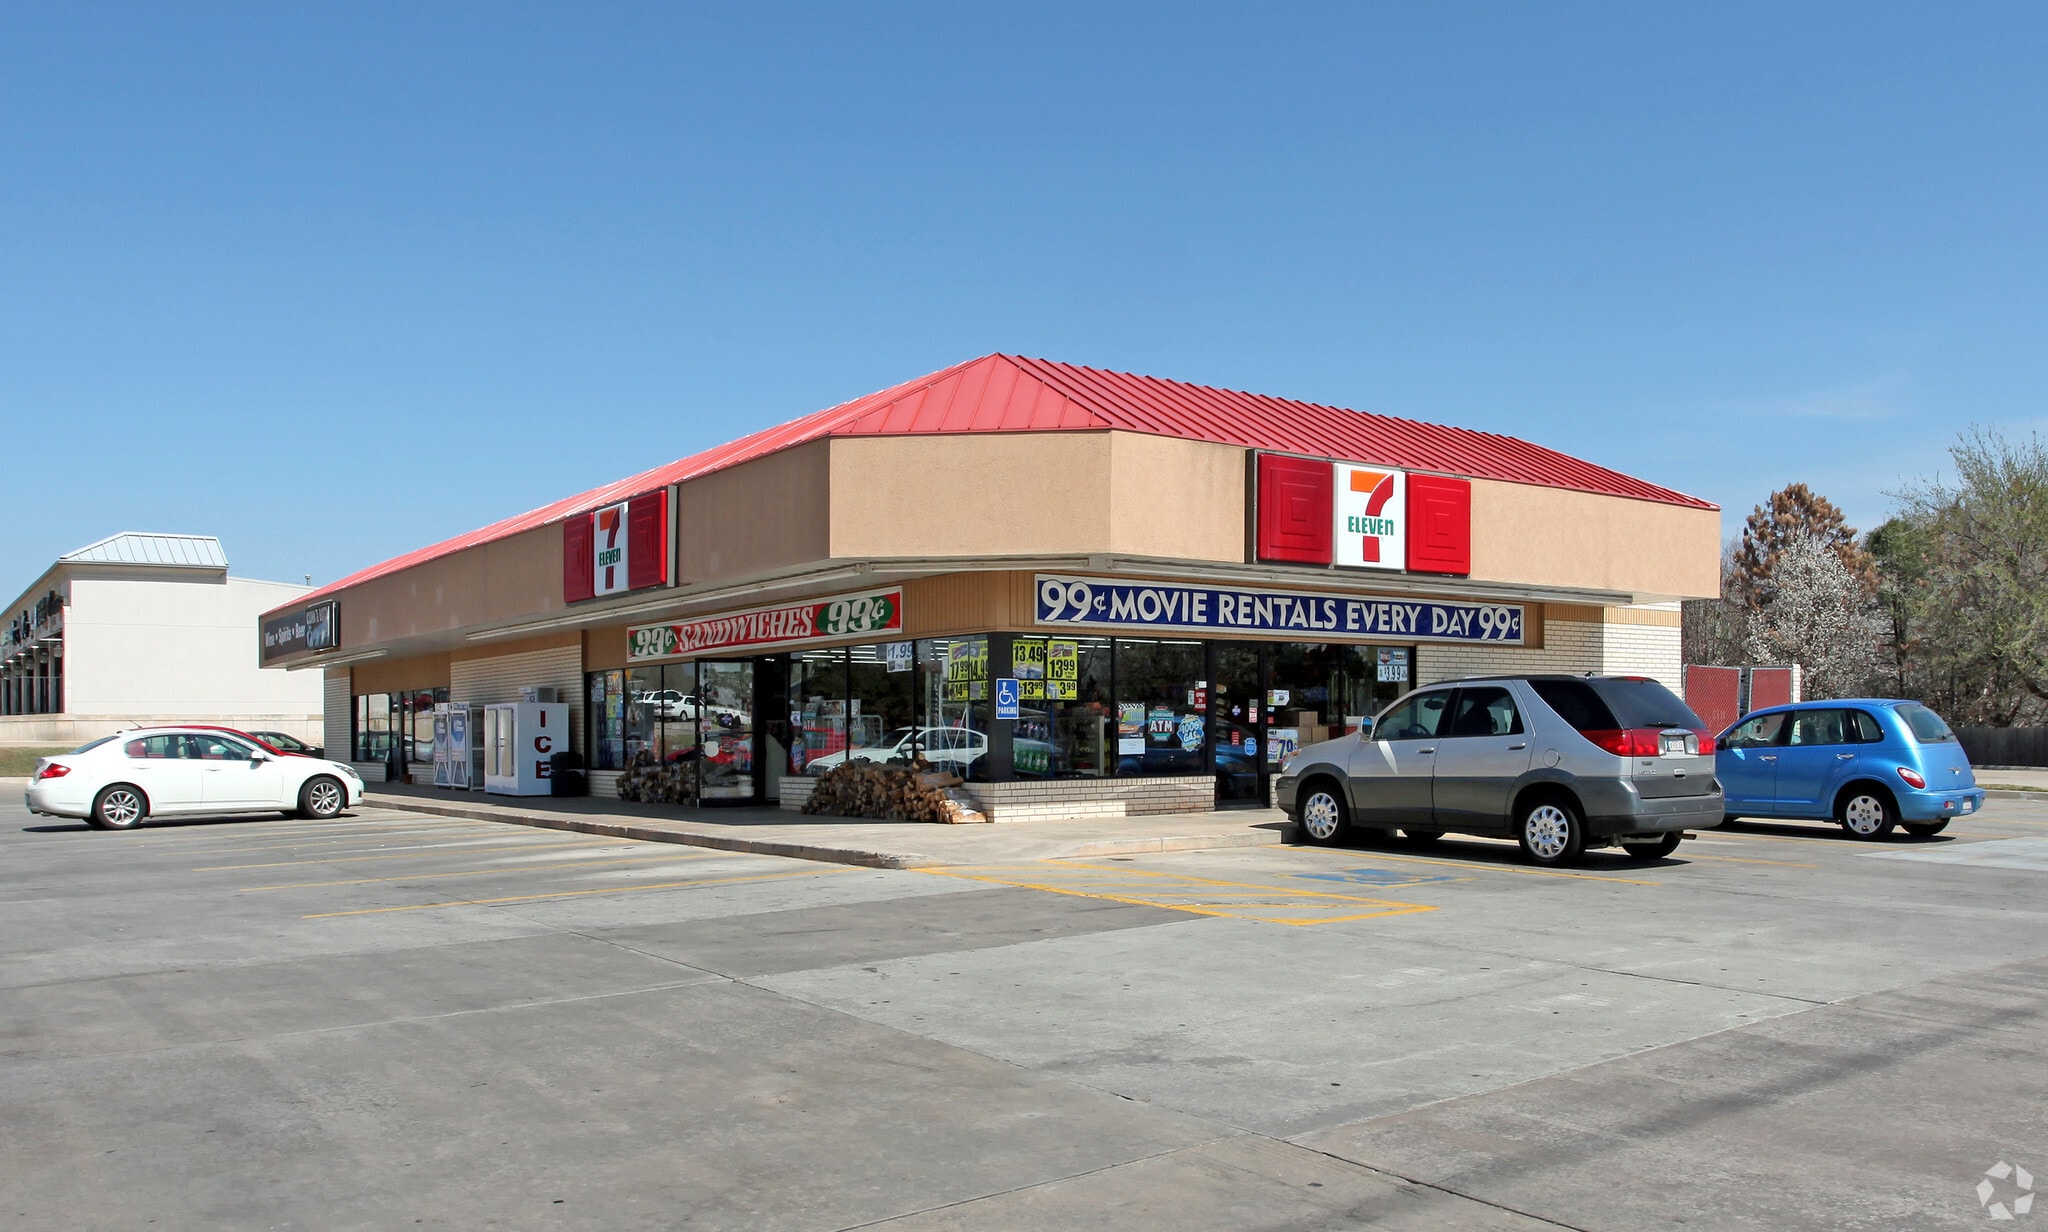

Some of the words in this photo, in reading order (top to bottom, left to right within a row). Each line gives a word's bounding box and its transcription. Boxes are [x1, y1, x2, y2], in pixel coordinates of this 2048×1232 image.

[1350, 470, 1394, 563] 7
[600, 508, 620, 590] 7
[680, 606, 815, 652] SANDWICHES
[1108, 588, 1208, 623] MOVIE
[1218, 594, 1338, 631] RENTALS
[1346, 602, 1422, 633] EVERY
[1431, 607, 1476, 636] DAY
[998, 706, 1017, 715] PARKING
[1150, 720, 1173, 732] ATM
